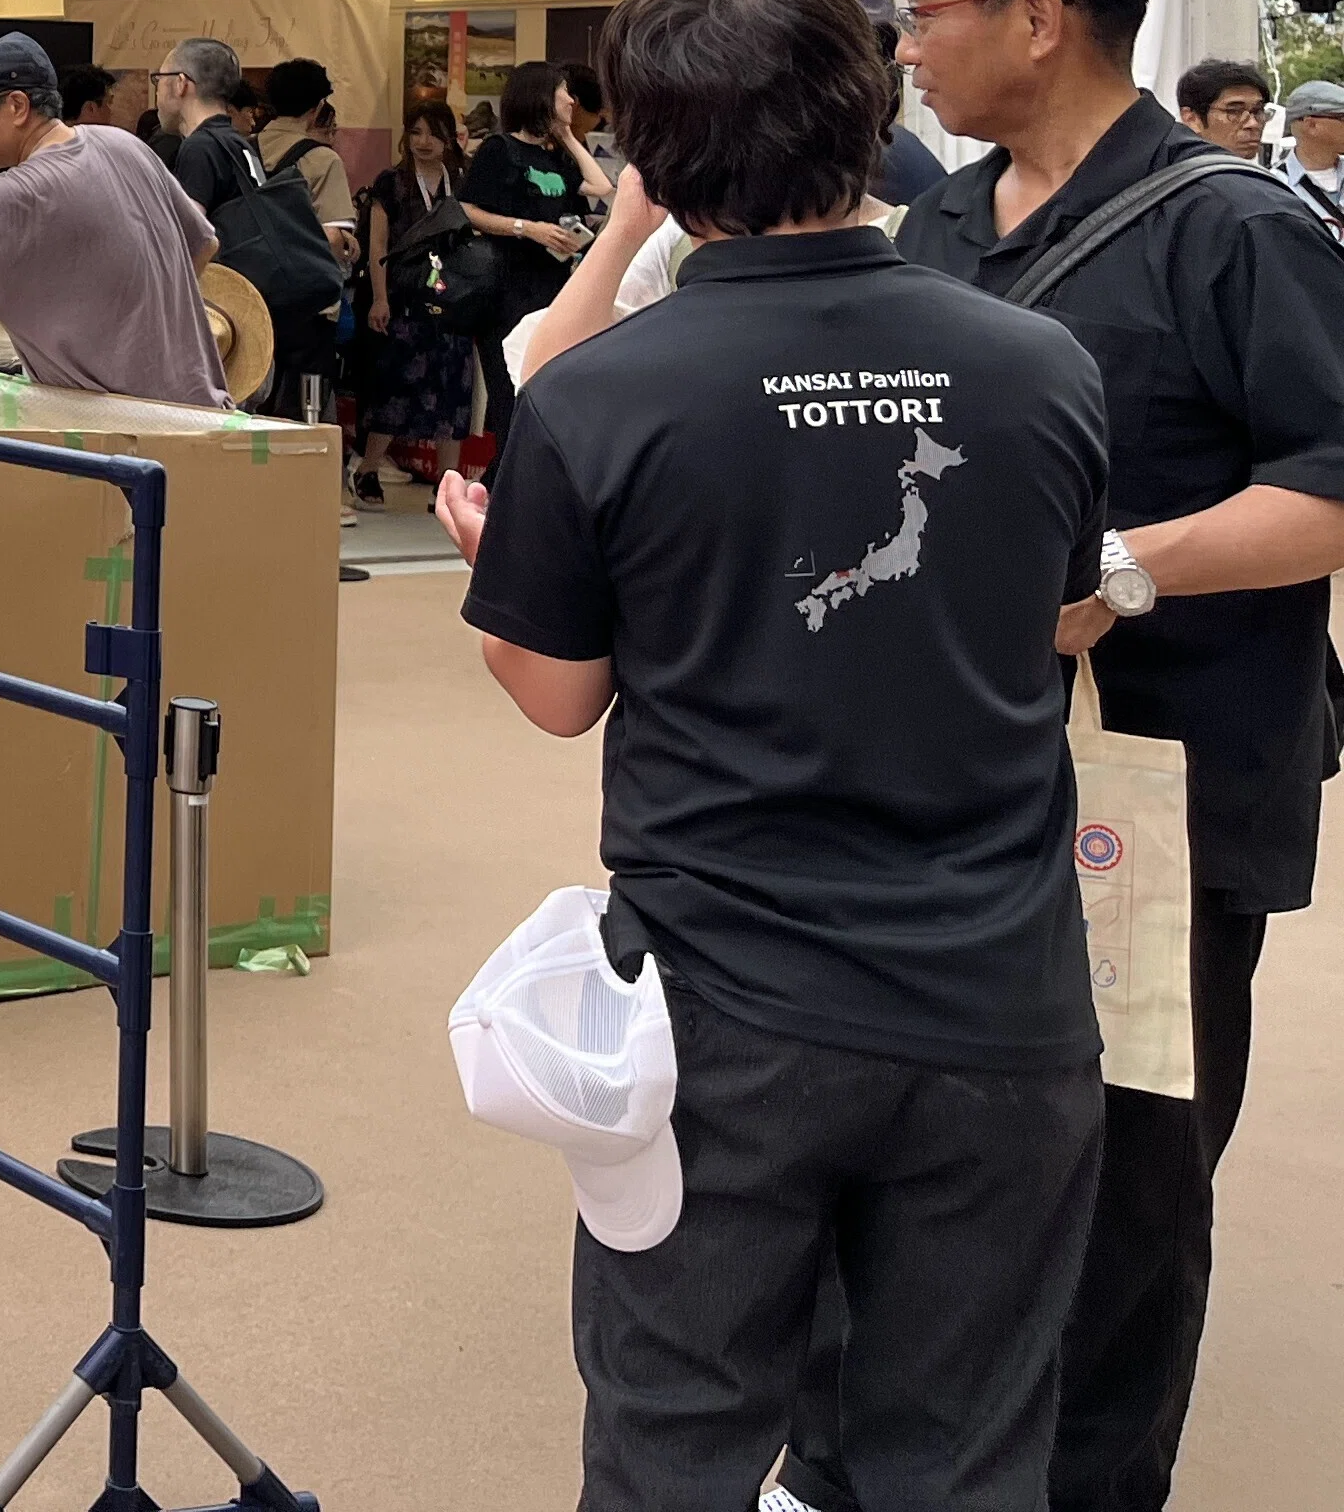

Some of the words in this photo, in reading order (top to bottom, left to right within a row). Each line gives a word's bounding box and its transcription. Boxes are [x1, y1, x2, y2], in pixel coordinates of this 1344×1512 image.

[762, 372, 853, 395] KANSAI
[858, 369, 951, 389] Pavilion
[778, 397, 944, 429] TOTTORI
